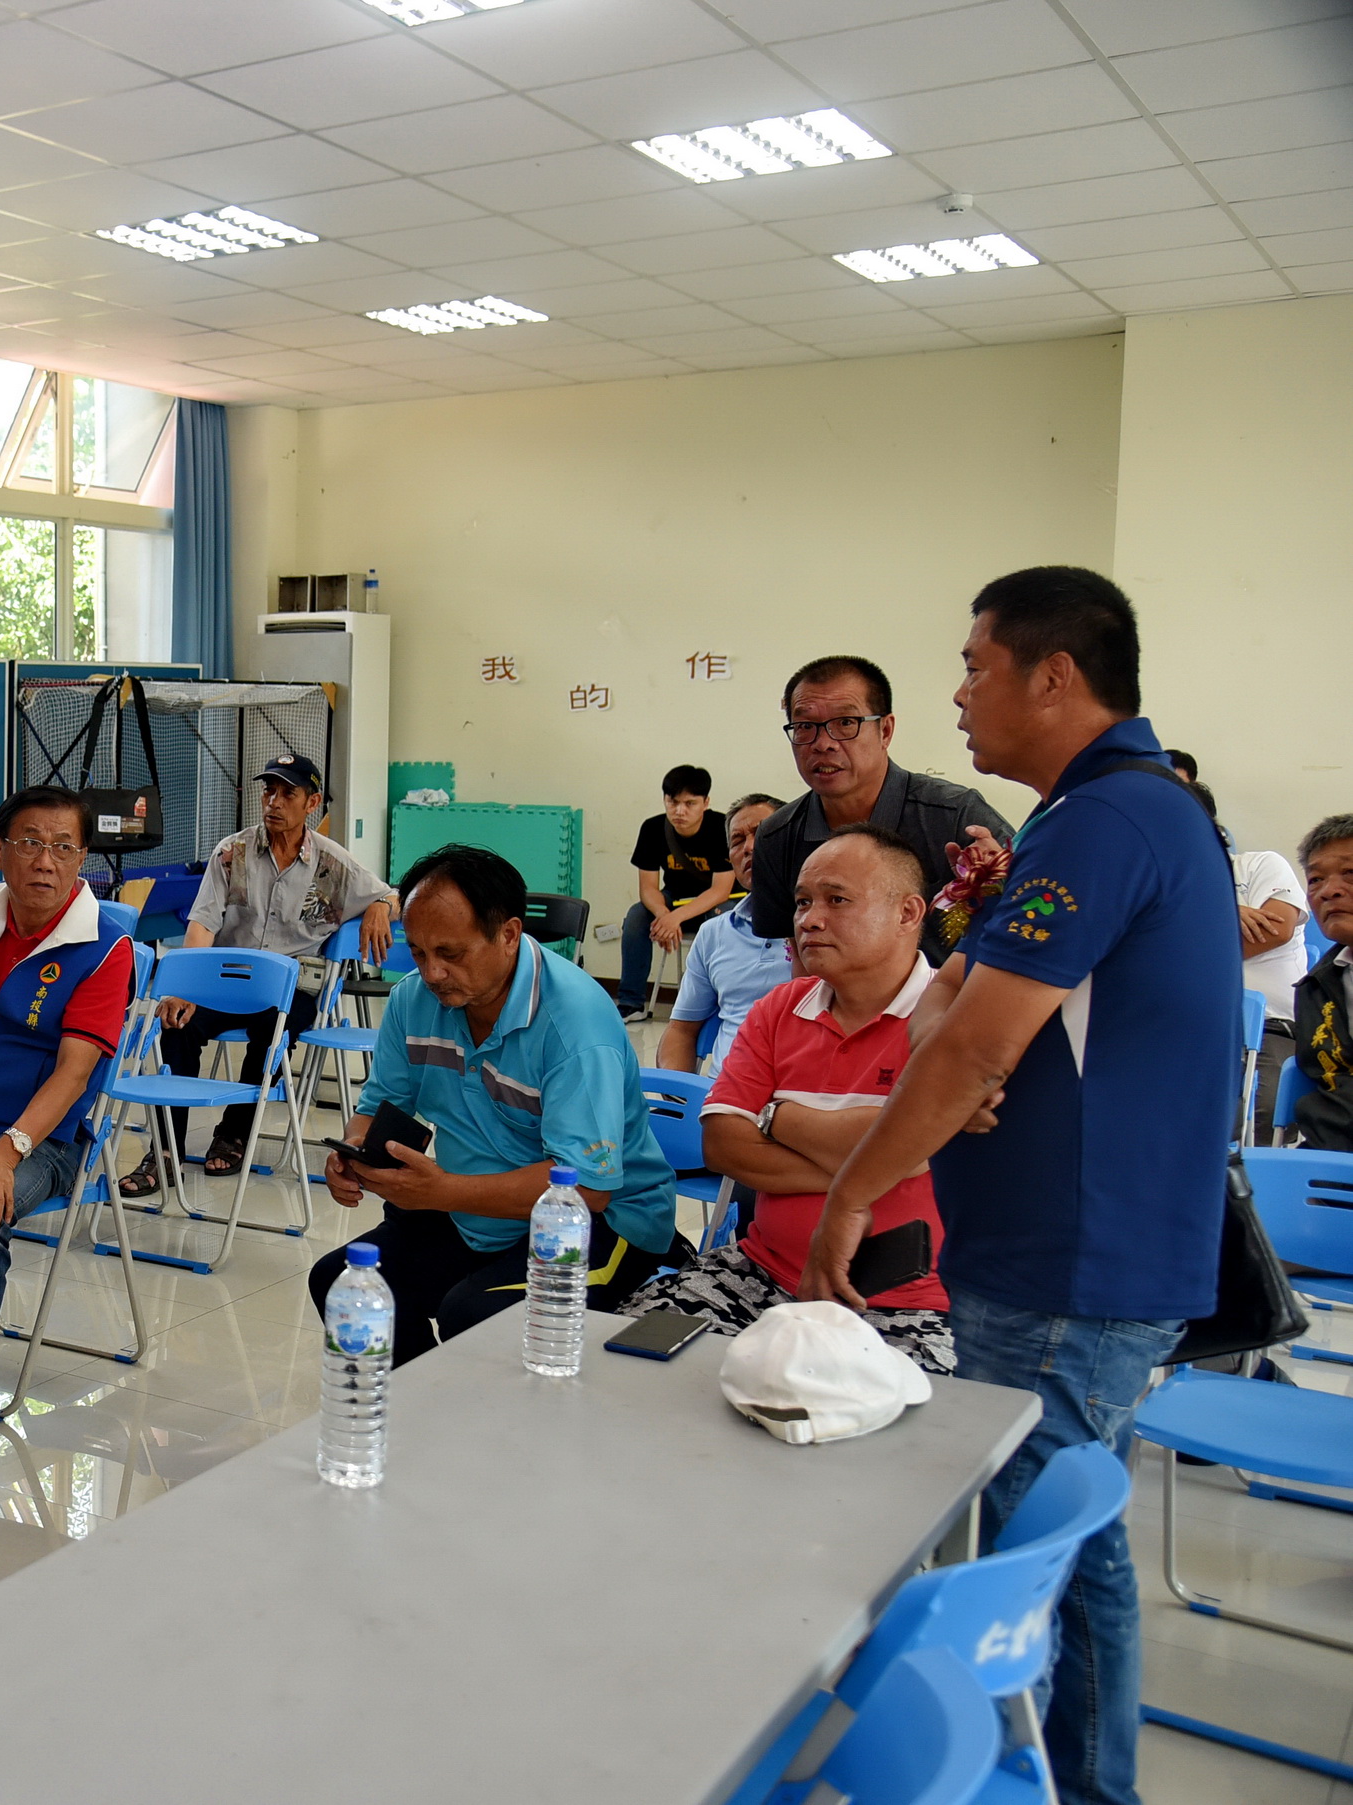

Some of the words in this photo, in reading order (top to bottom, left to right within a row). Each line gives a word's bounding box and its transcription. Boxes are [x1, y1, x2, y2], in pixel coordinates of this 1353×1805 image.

[481, 656, 517, 682] 我
[569, 684, 609, 710] 的
[685, 650, 728, 680] 作
[26, 985, 48, 1031] 南投縣
